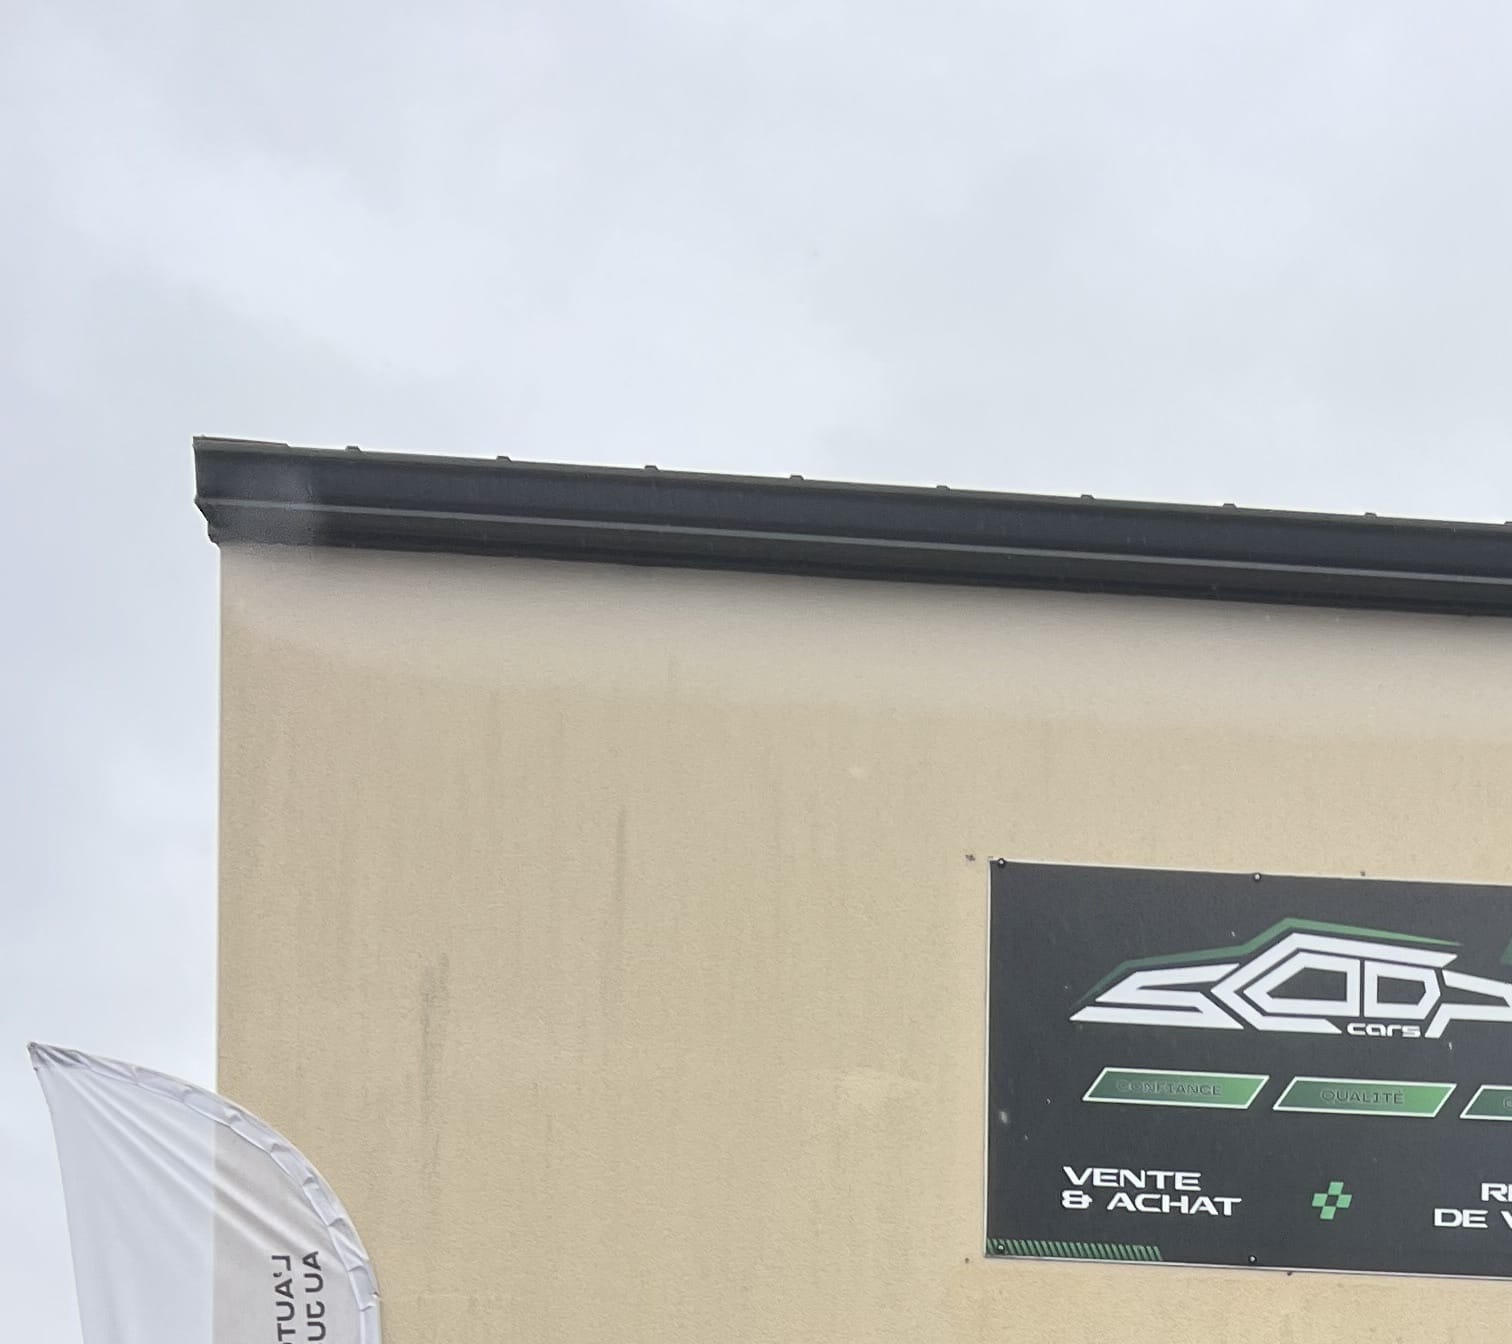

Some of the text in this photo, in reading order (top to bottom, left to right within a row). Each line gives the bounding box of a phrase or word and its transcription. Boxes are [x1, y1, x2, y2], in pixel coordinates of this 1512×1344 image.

[1347, 1023, 1421, 1038] cars
[1062, 1166, 1201, 1191] VENTE
[1061, 1190, 1242, 1217] & ACHAT
[1433, 1207, 1487, 1229] DE
